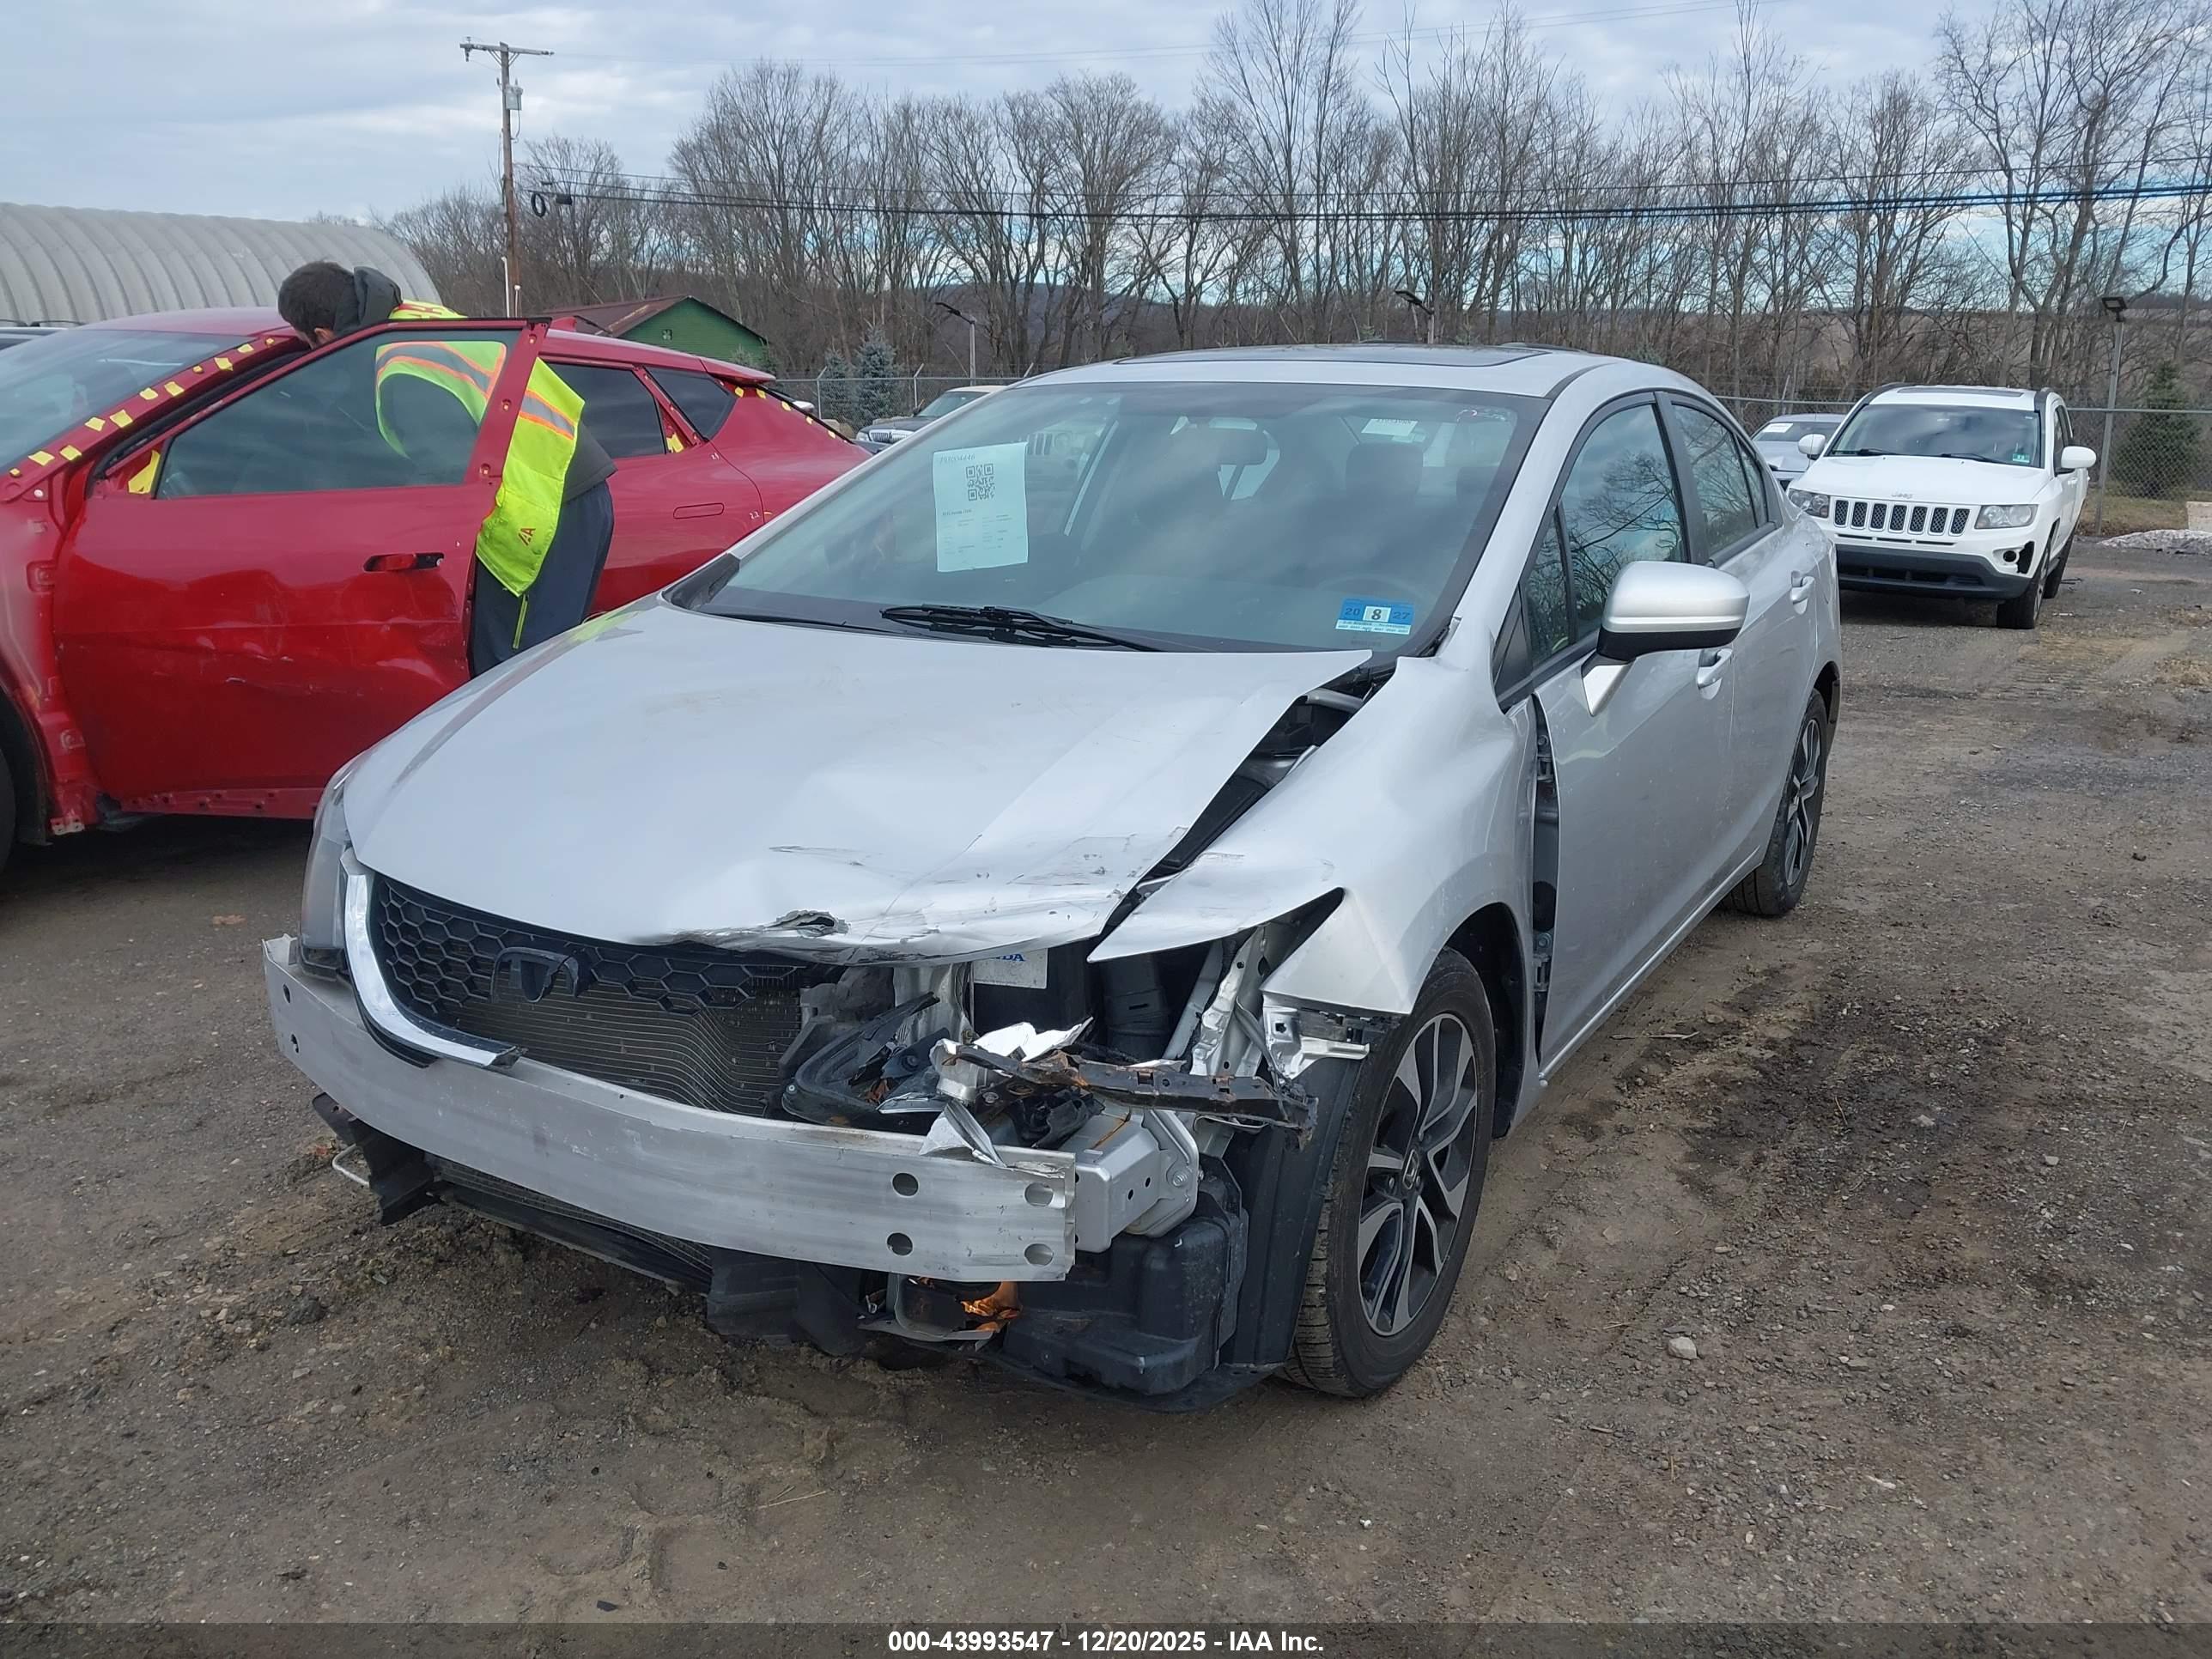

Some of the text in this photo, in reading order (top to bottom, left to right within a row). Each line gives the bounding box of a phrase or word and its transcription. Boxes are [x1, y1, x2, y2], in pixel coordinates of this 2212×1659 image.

[1345, 607, 1410, 620] 20 8 27
[996, 953, 1026, 962] DA
